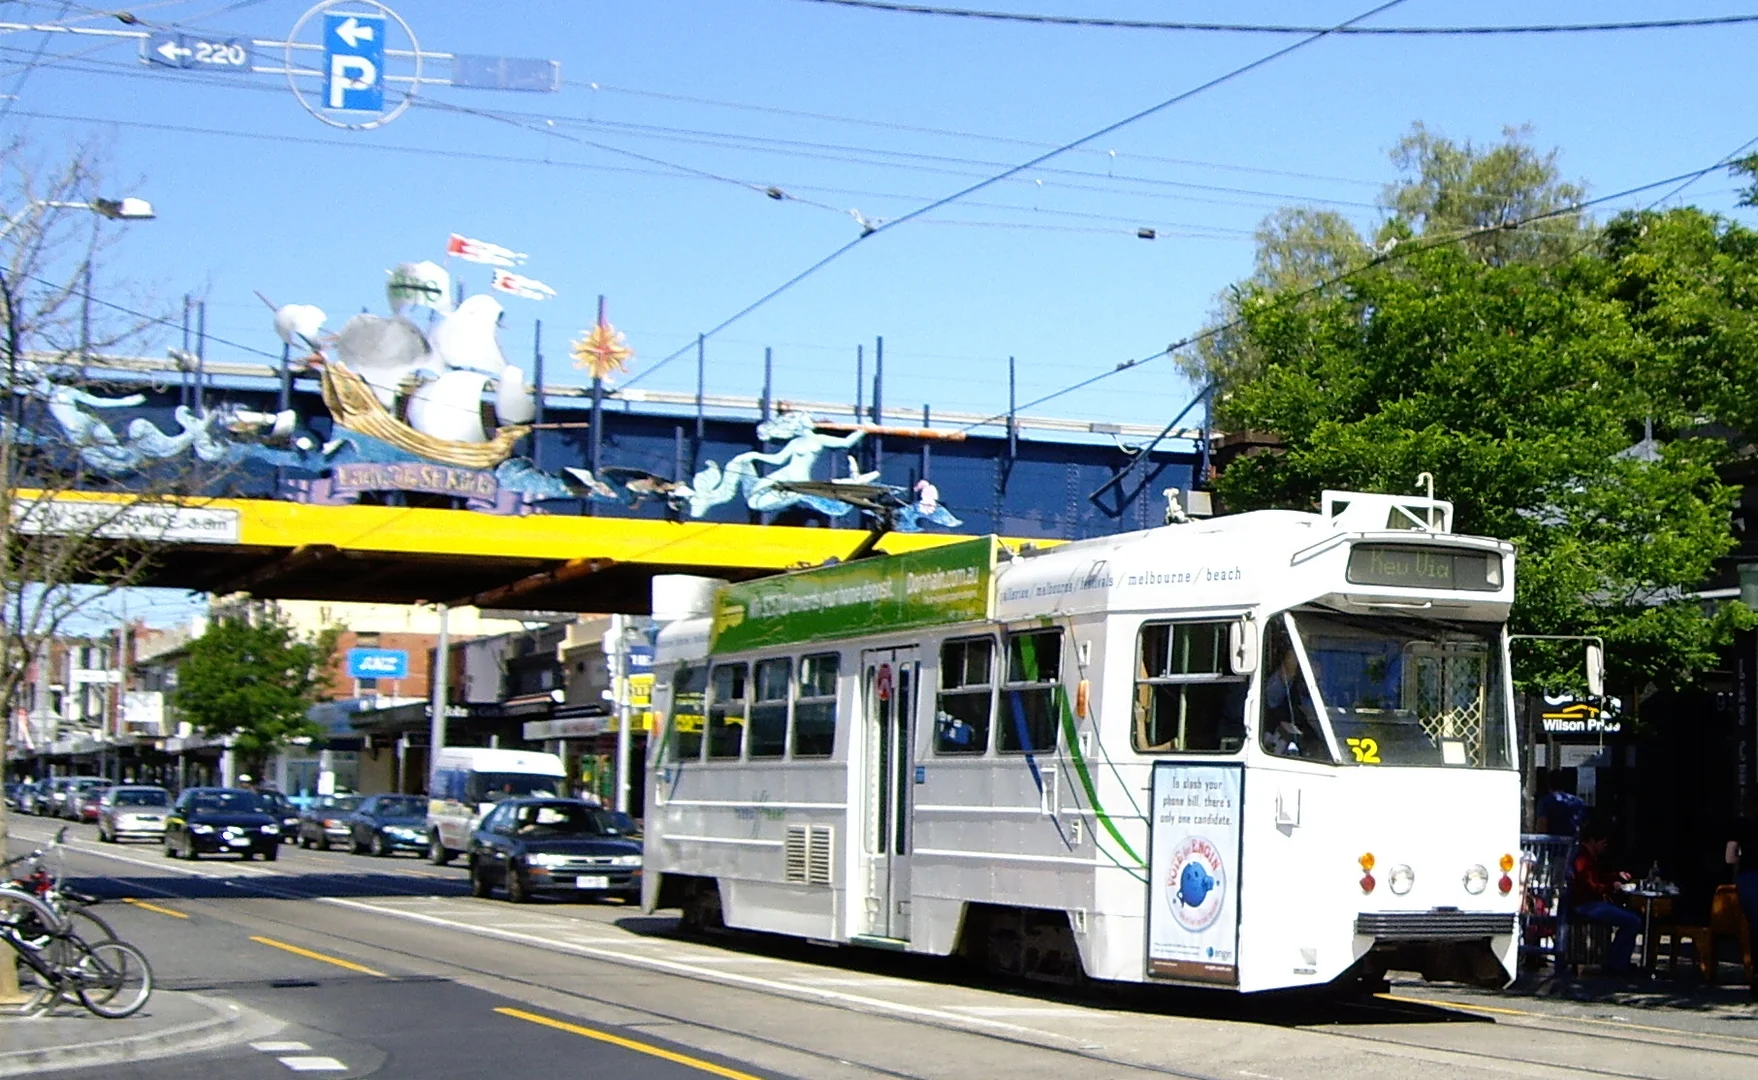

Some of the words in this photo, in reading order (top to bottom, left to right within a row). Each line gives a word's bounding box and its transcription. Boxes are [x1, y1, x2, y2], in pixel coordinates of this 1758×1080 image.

[195, 42, 246, 66] 220
[329, 54, 377, 108] P
[1128, 571, 1191, 586] melbourne
[1206, 566, 1242, 582] beach
[1542, 718, 1585, 732] Wilson
[1172, 776, 1180, 789] To
[1205, 781, 1222, 792] your
[1163, 794, 1184, 808] phone
[1160, 811, 1175, 826] only
[1178, 815, 1191, 825] one
[1167, 850, 1184, 887] VOTE
[1191, 838, 1220, 872] ENGIN
